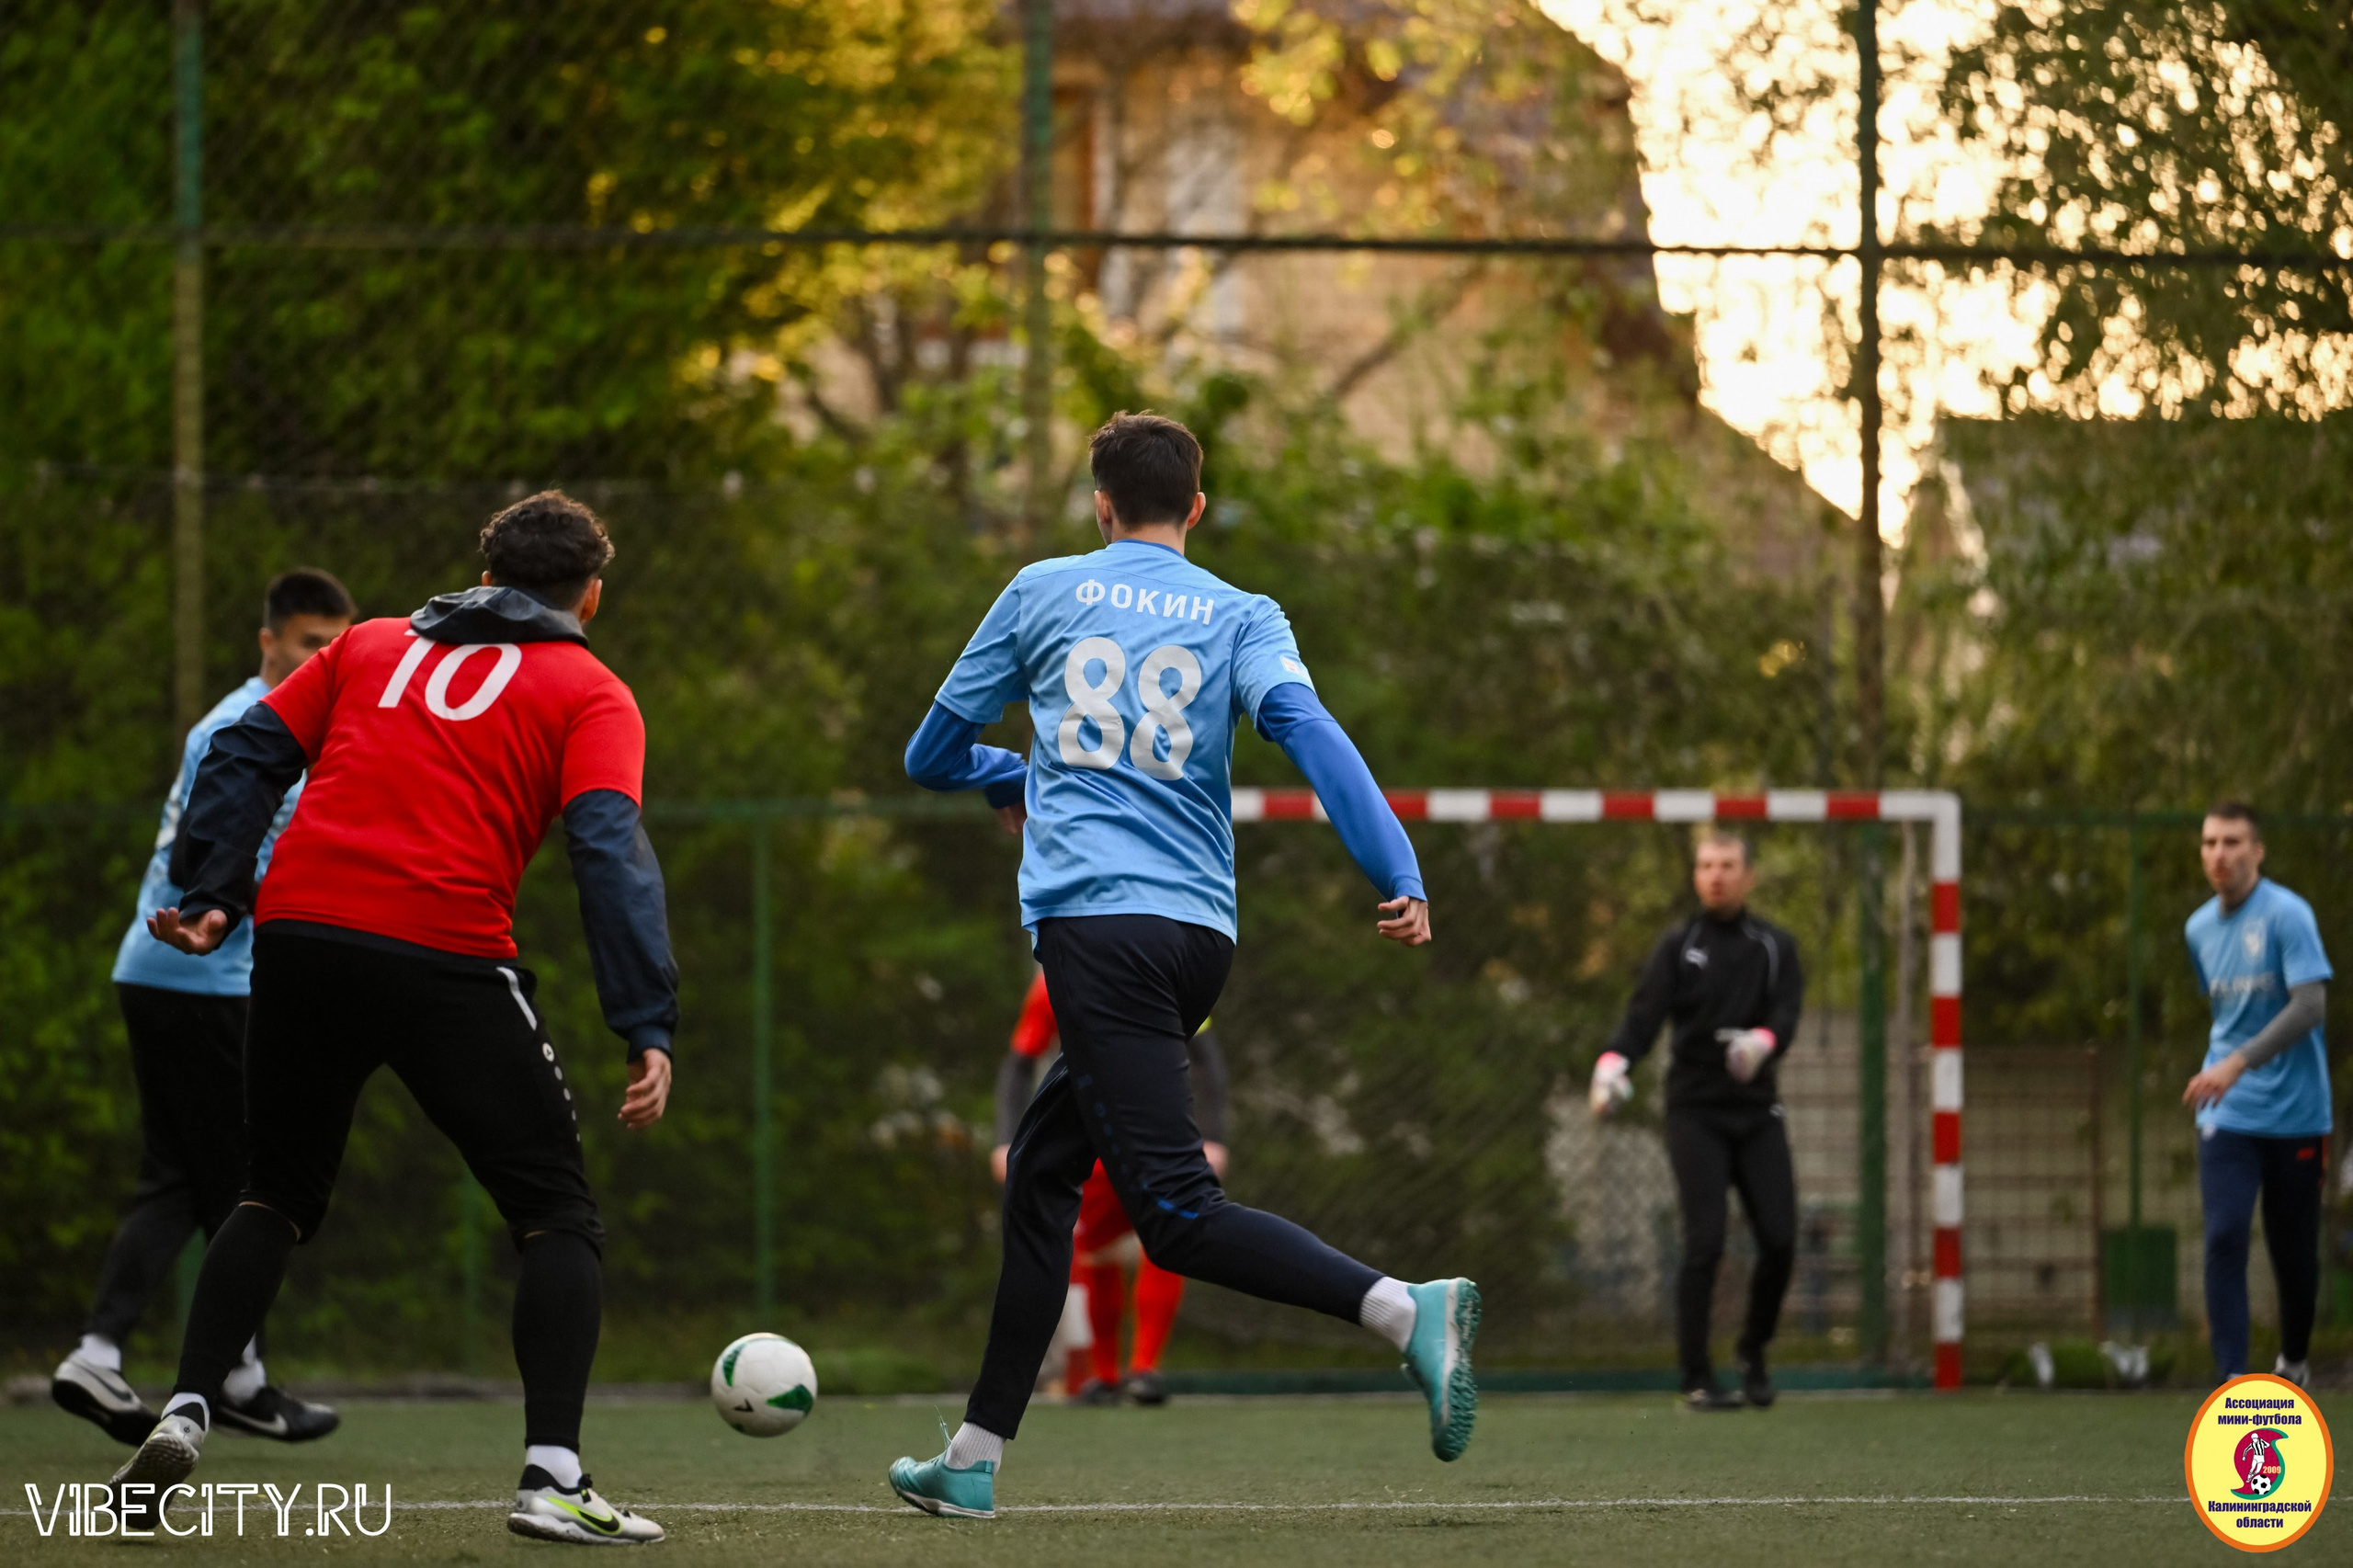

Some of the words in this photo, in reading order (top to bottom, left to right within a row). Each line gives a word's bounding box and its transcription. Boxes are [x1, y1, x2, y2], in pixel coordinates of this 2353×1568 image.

[1075, 579, 1214, 625] ФОКИН
[378, 629, 522, 722] 10
[1058, 636, 1201, 780] 88
